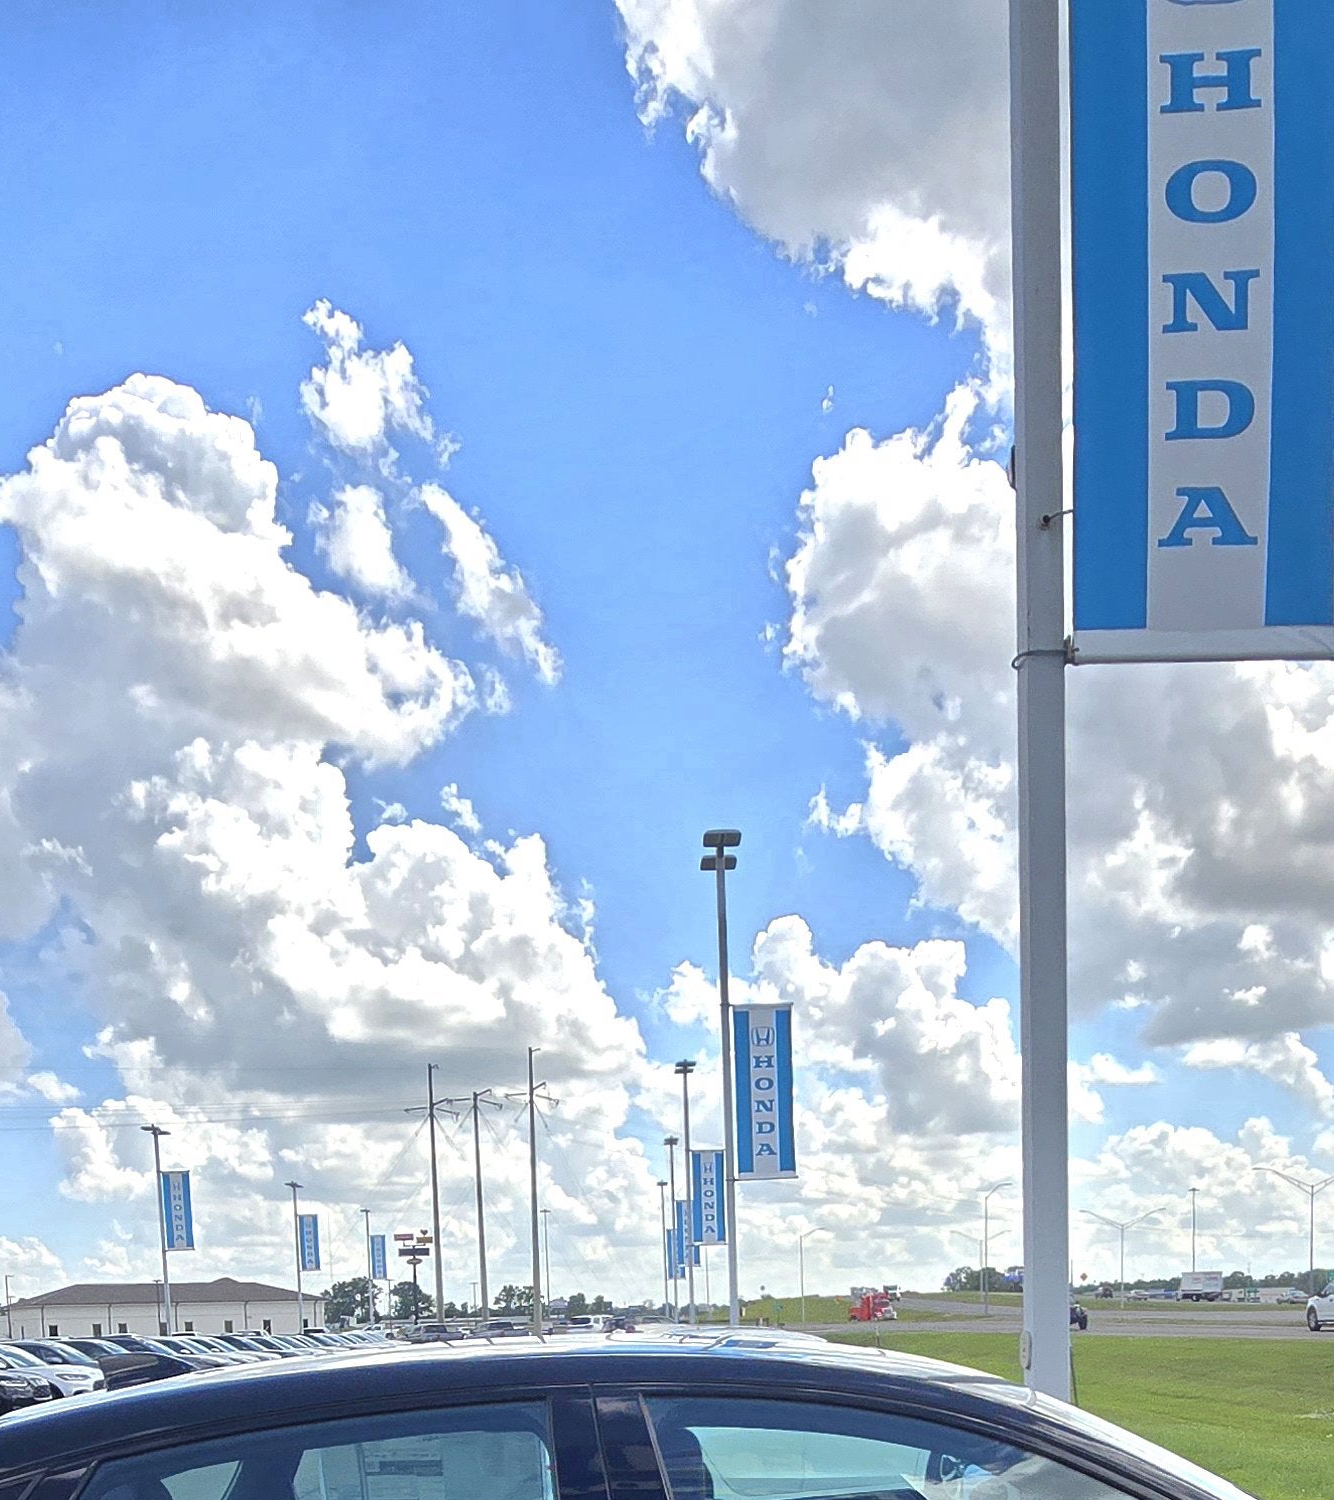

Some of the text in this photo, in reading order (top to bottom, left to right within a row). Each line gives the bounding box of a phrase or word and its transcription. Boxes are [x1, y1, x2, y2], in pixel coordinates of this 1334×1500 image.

[1157, 48, 1262, 548] HONDA
[753, 1055, 777, 1157] HONDA
[173, 1194, 185, 1241] HONDA
[703, 1178, 716, 1234] HONDA
